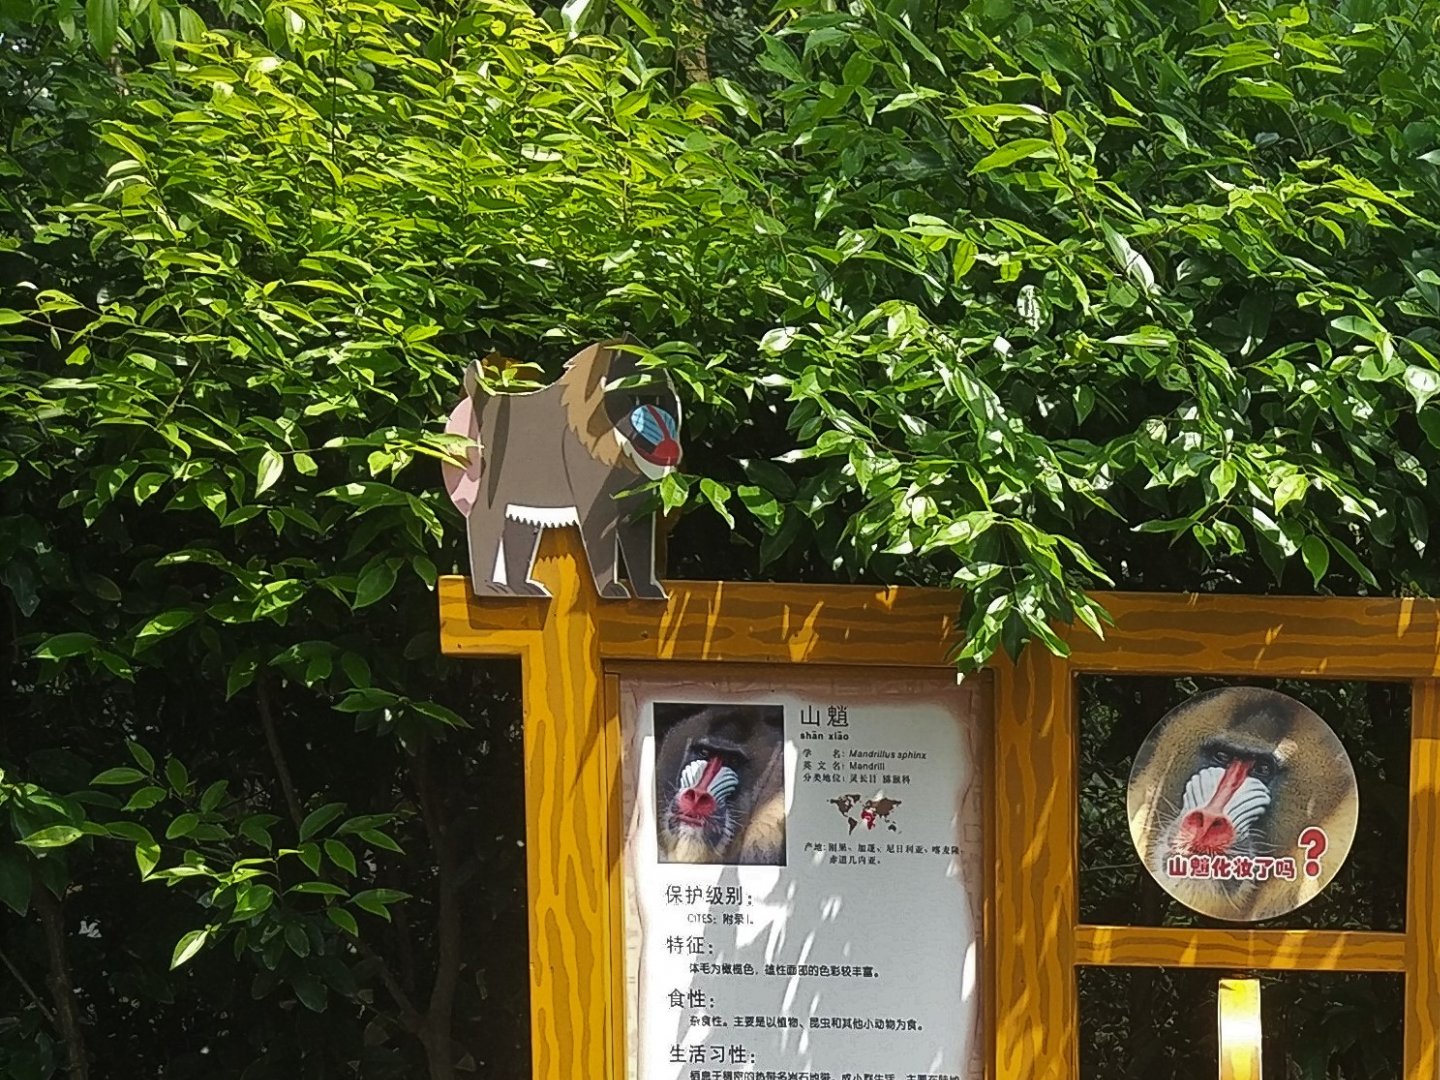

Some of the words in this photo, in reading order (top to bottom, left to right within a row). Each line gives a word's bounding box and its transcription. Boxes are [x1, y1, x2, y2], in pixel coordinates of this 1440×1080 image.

[800, 705, 849, 727] 山魈
[849, 750, 895, 759] Mandrillus
[897, 750, 928, 760] sphinx
[849, 761, 885, 770] Mandrill
[666, 885, 752, 906] 保护级别：
[666, 936, 713, 954] 特征：
[668, 988, 716, 1009] 食性：
[669, 1044, 756, 1064] 生活习性：
